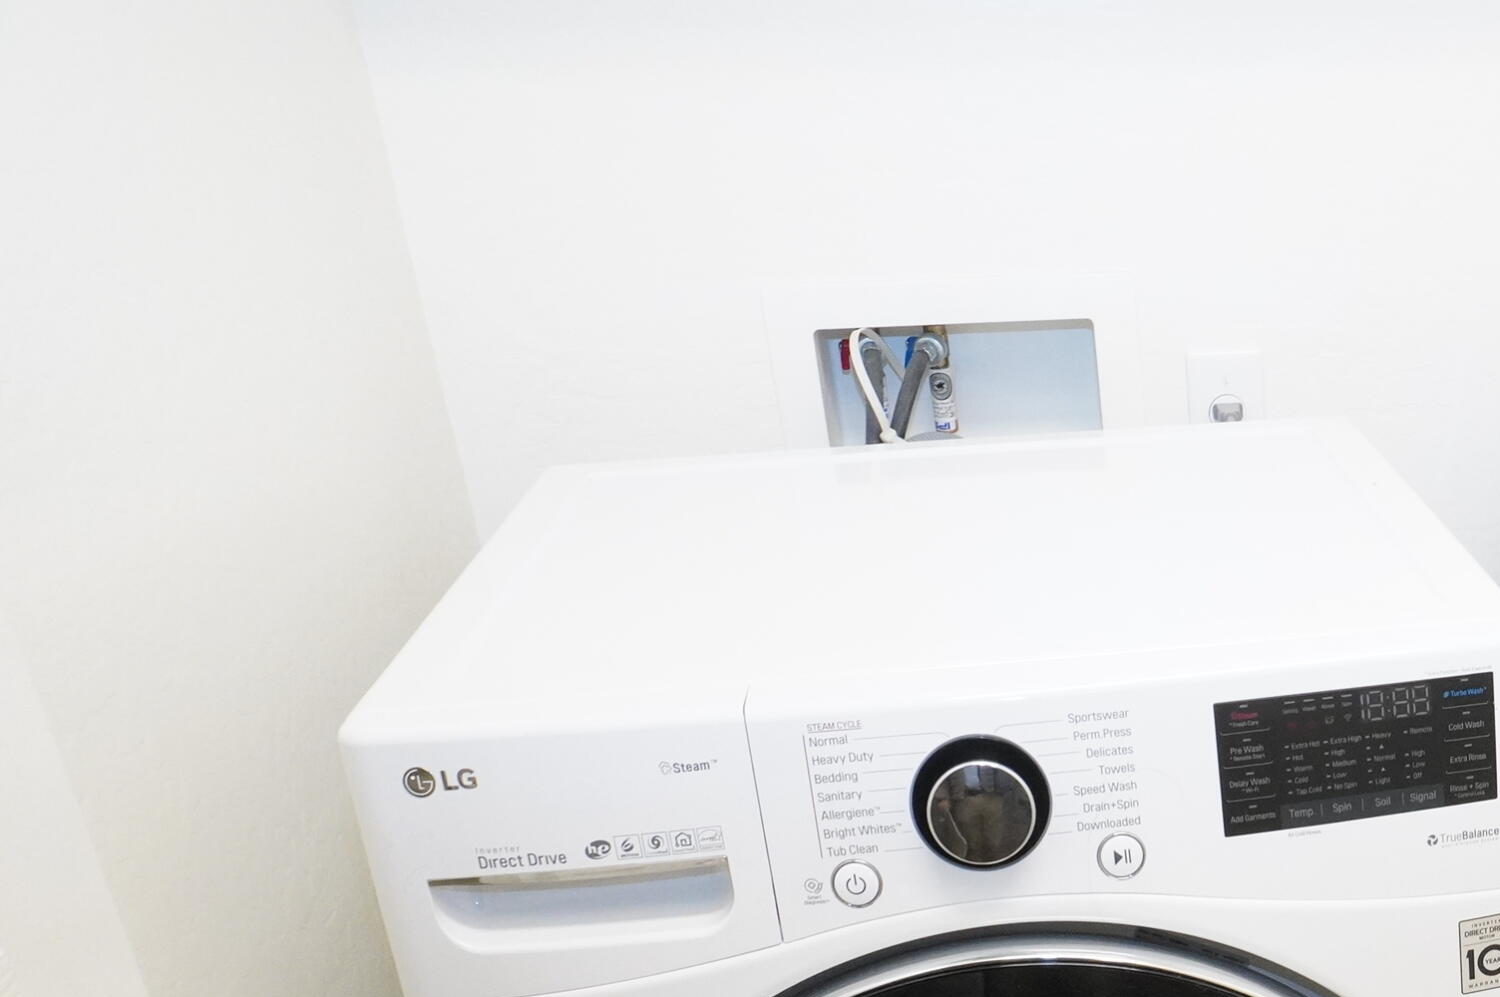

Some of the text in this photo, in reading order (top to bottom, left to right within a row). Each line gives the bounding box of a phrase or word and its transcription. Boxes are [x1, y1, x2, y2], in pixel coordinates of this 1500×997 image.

[1067, 709, 1129, 725] Sportswear
[807, 719, 862, 732] STEAM CYCLE
[1448, 720, 1485, 732] Cold Wash
[1102, 727, 1132, 738] Press
[808, 734, 848, 747] Normal
[1330, 734, 1362, 746] Extra High
[1086, 745, 1134, 759] Delicates
[1230, 744, 1264, 755] Pre Wash
[1411, 749, 1426, 759] High
[812, 751, 873, 766] Heavy Duty
[1450, 755, 1468, 764] Extra
[1099, 763, 1136, 775] Towels
[440, 768, 478, 791] LG
[814, 771, 858, 784] Bedding
[1250, 776, 1271, 787] Wash
[1375, 777, 1391, 786] Light
[1073, 780, 1138, 797] Speed Wash
[817, 790, 862, 803] Sanitary
[1374, 796, 1392, 808] Soil
[1410, 790, 1437, 804] Signal
[1083, 798, 1139, 813] Drain+Spin
[1332, 801, 1353, 813] Spin
[1231, 811, 1276, 824] Add Garments
[1289, 807, 1314, 819] Temp
[1077, 815, 1141, 832] Downloaded
[823, 827, 856, 840] Bright
[475, 846, 520, 855] Inverter
[826, 844, 879, 858] Tub Clean
[478, 852, 568, 869] Direct Drive
[1464, 927, 1488, 938] DIRECT
